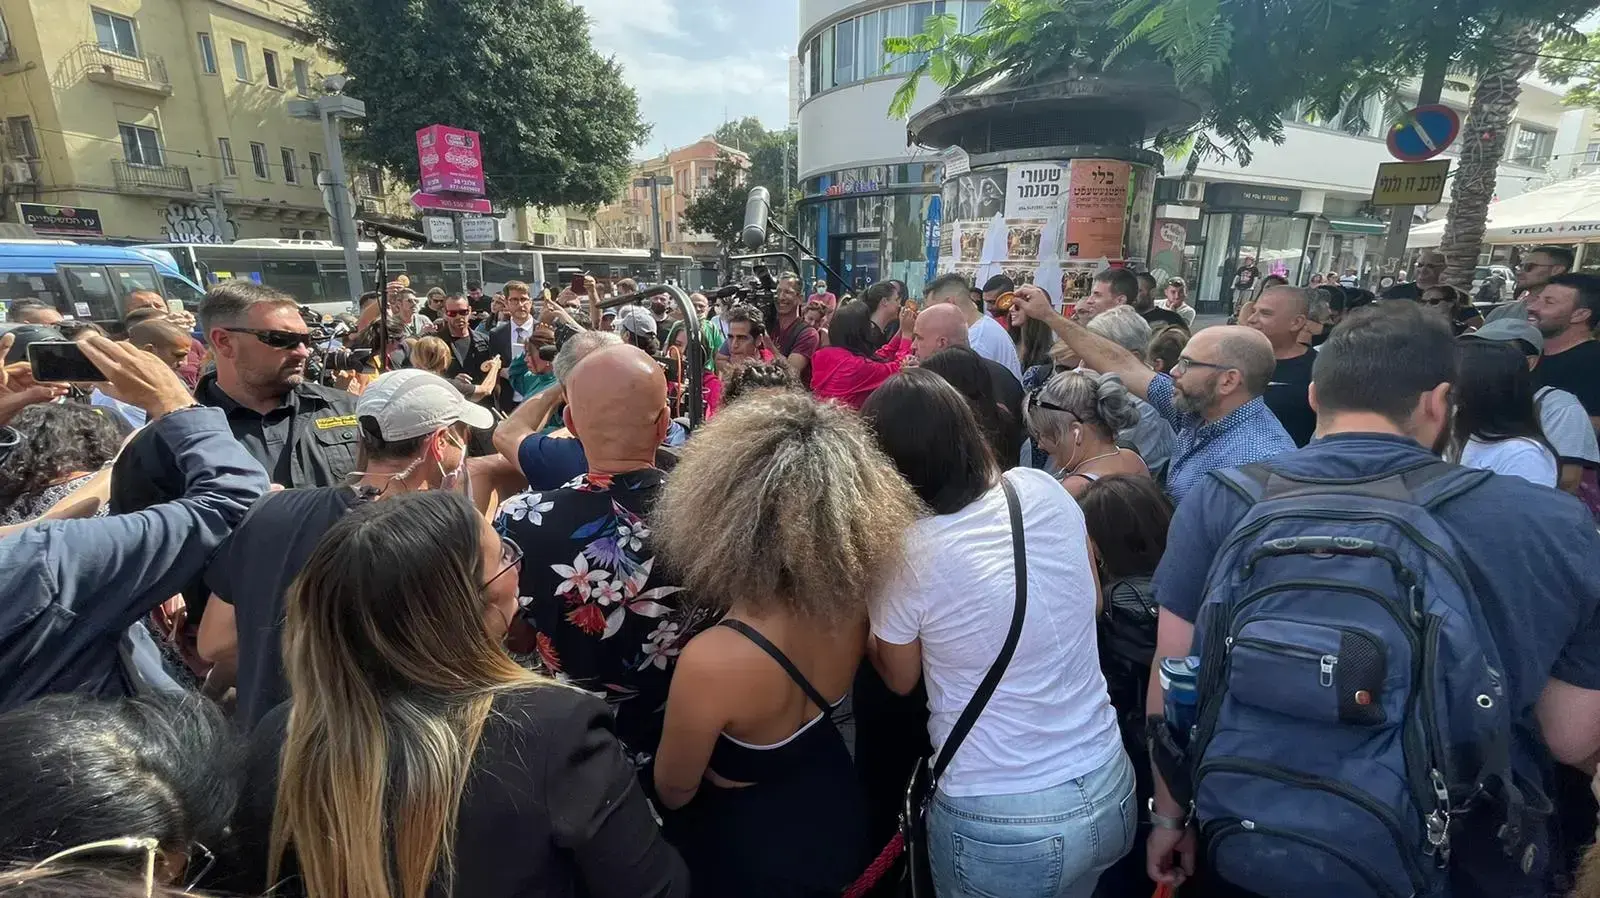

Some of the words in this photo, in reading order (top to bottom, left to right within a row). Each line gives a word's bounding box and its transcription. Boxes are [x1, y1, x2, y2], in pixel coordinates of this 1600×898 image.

[1020, 168, 1061, 183] שעורי
[1091, 165, 1115, 185] בלי
[1017, 184, 1060, 198] פסנתר
[82, 218, 95, 227] עץ
[1511, 226, 1553, 234] STELLA
[168, 232, 224, 245] LUKKA
